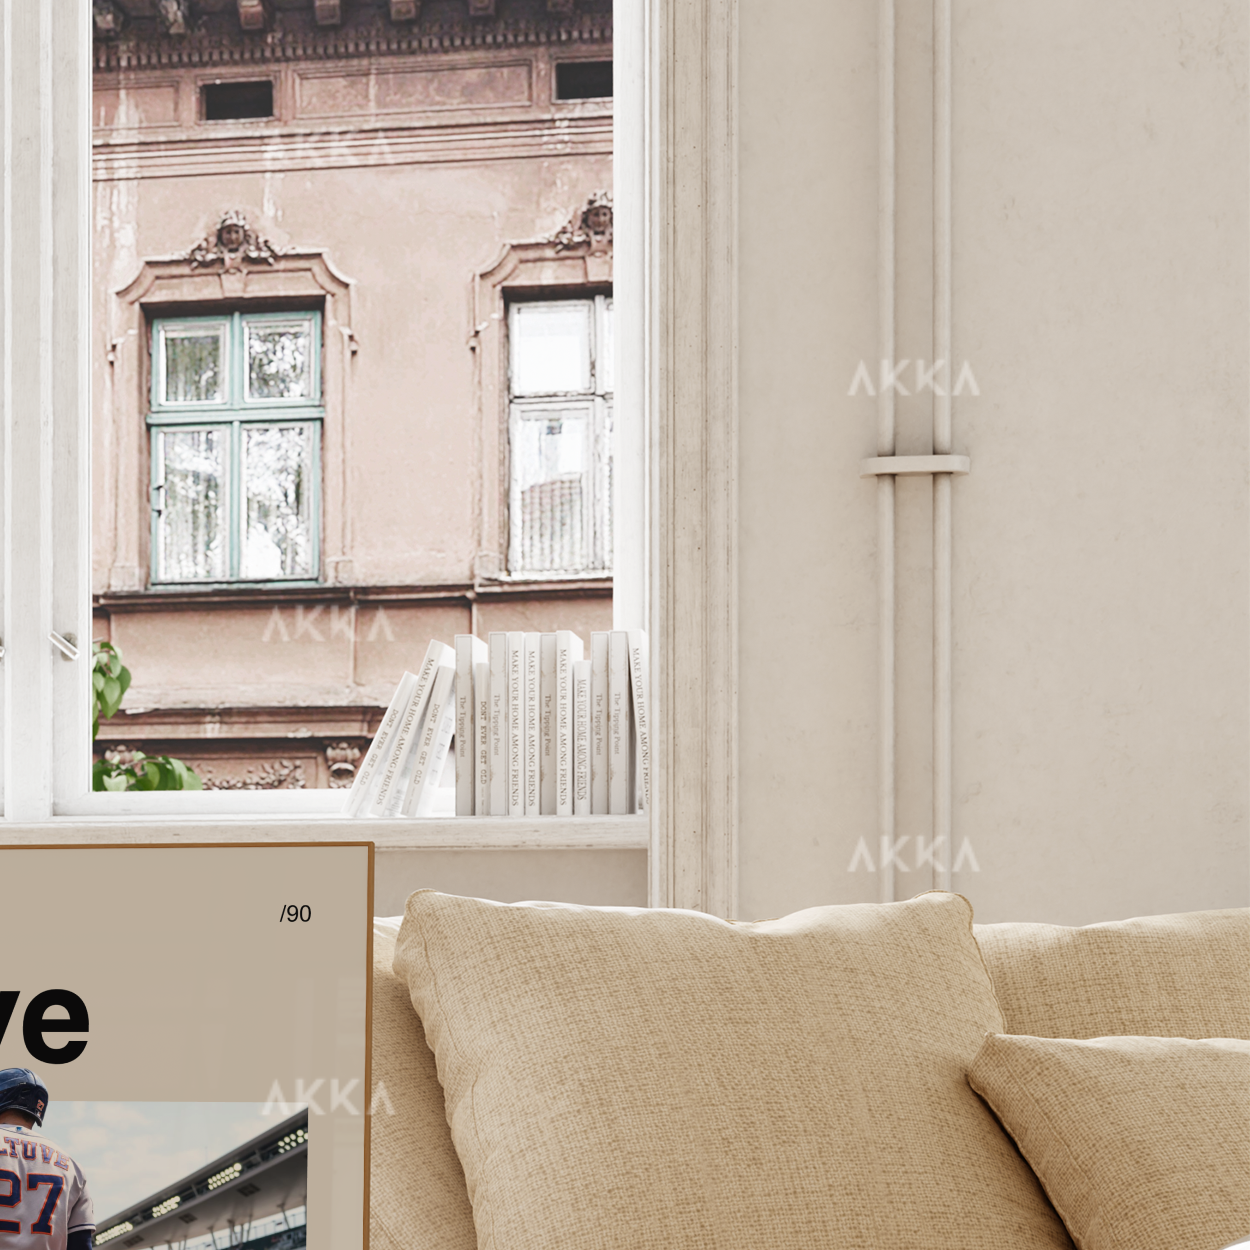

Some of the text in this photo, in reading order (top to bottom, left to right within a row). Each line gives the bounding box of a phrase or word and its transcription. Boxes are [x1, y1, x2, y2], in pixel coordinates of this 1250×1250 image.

[360, 709, 399, 785] DONT EVER GET OLD
[376, 658, 434, 806] MAKE YOUR HOME AMONG FRIENDS
[414, 704, 440, 785] DONT EVER GET OLD
[543, 710, 551, 736] Tipping
[279, 904, 312, 924] /90
